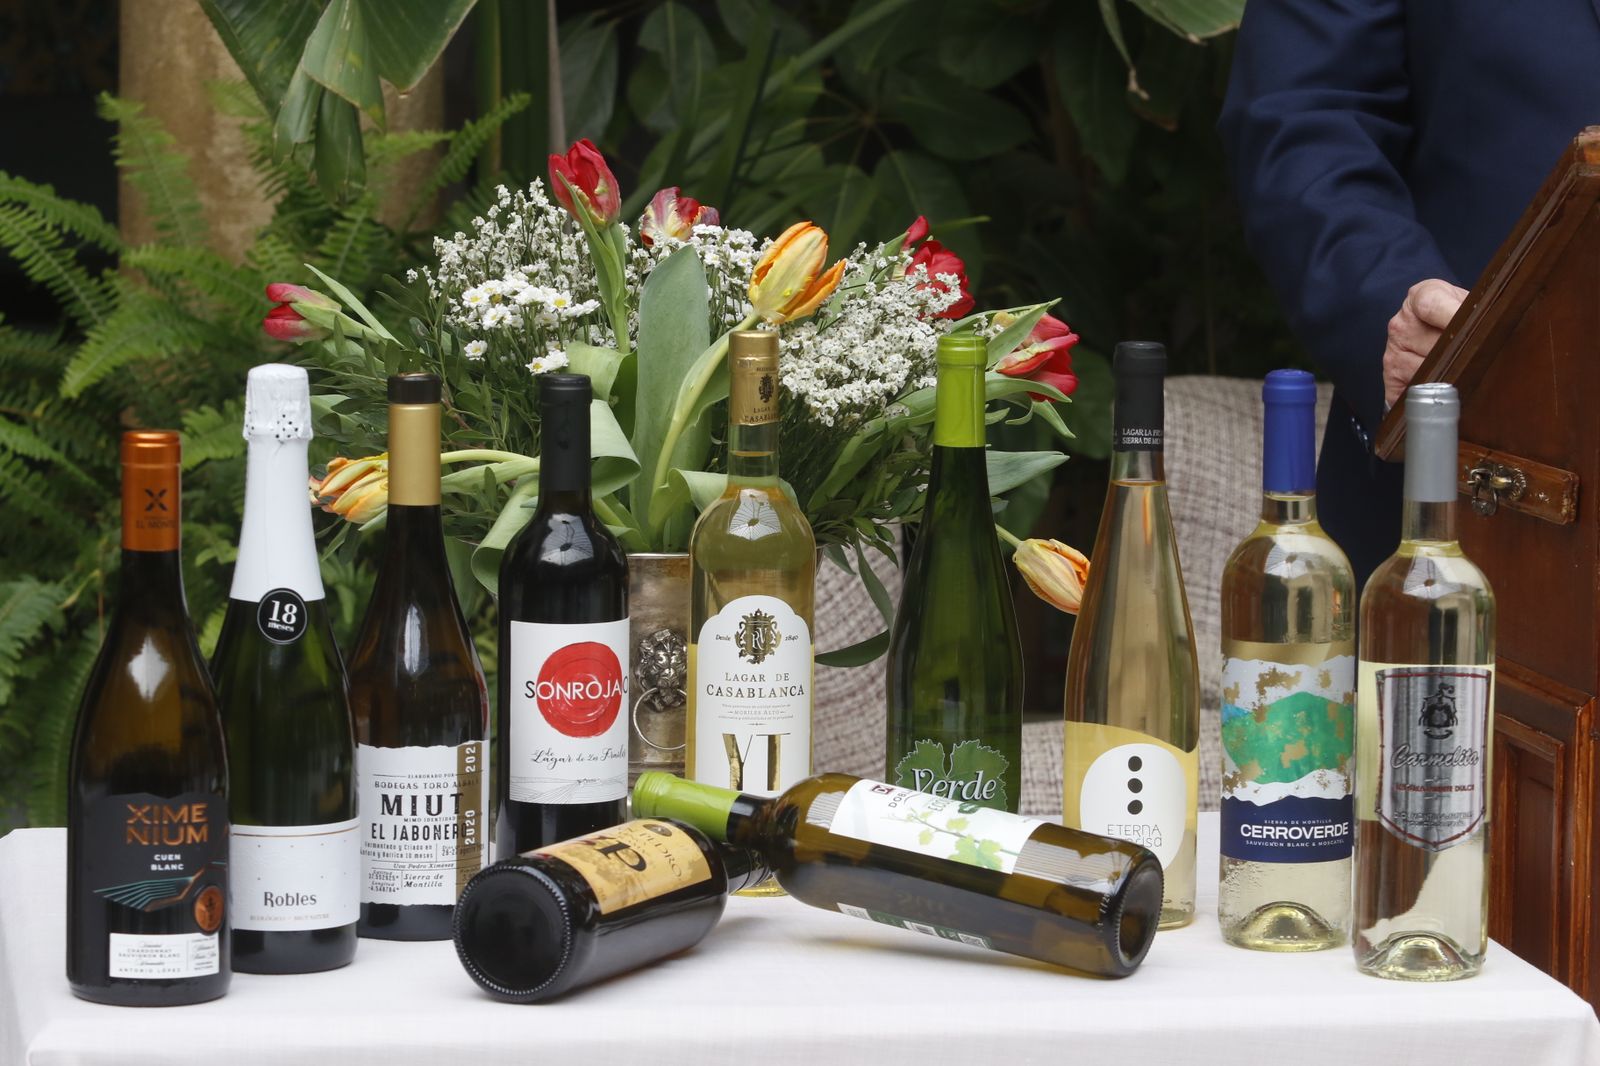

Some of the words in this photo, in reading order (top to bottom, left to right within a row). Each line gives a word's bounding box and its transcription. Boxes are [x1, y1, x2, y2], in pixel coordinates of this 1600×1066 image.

[268, 600, 298, 624] 18
[267, 622, 295, 632] meses
[725, 672, 766, 683] LAGAR
[776, 673, 790, 682] DE
[706, 684, 805, 699] CASABLANCA
[575, 753, 585, 762] de
[1390, 744, 1480, 769] Carmelita
[374, 780, 418, 790] BODEGAS
[423, 781, 449, 789] TORO
[910, 768, 997, 800] Verde
[126, 803, 209, 824] XIME
[380, 793, 464, 816] MIUT
[126, 825, 209, 845] NIUM
[371, 823, 386, 840] EL
[393, 823, 467, 841] JABONERO
[465, 810, 476, 845] 2020
[1240, 822, 1349, 840] CERROVERDE
[150, 863, 184, 871] BLANC
[403, 873, 431, 881] Sierra
[263, 891, 317, 908] Robles
